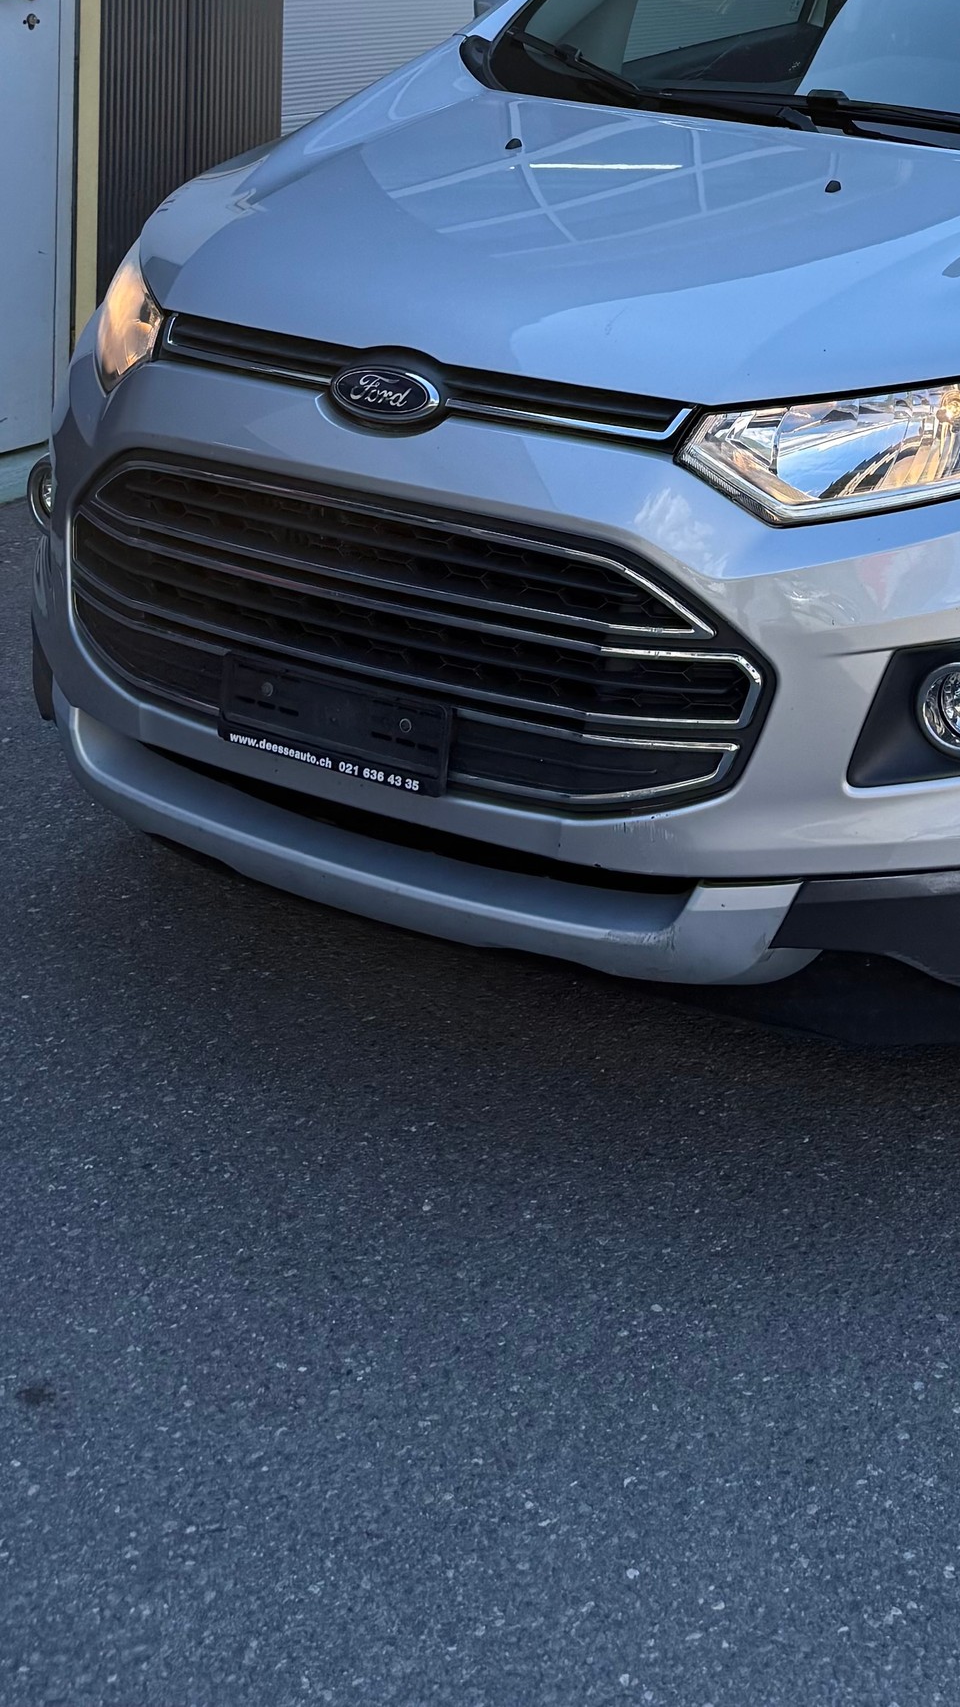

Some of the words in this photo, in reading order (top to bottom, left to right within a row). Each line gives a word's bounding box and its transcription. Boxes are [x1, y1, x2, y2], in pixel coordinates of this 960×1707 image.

[349, 373, 413, 408] Ford
[229, 732, 333, 769] www.deesseauto.ch
[338, 761, 359, 776] 021
[363, 767, 385, 782] 636
[387, 773, 402, 787] 43
[405, 778, 420, 792] 35
